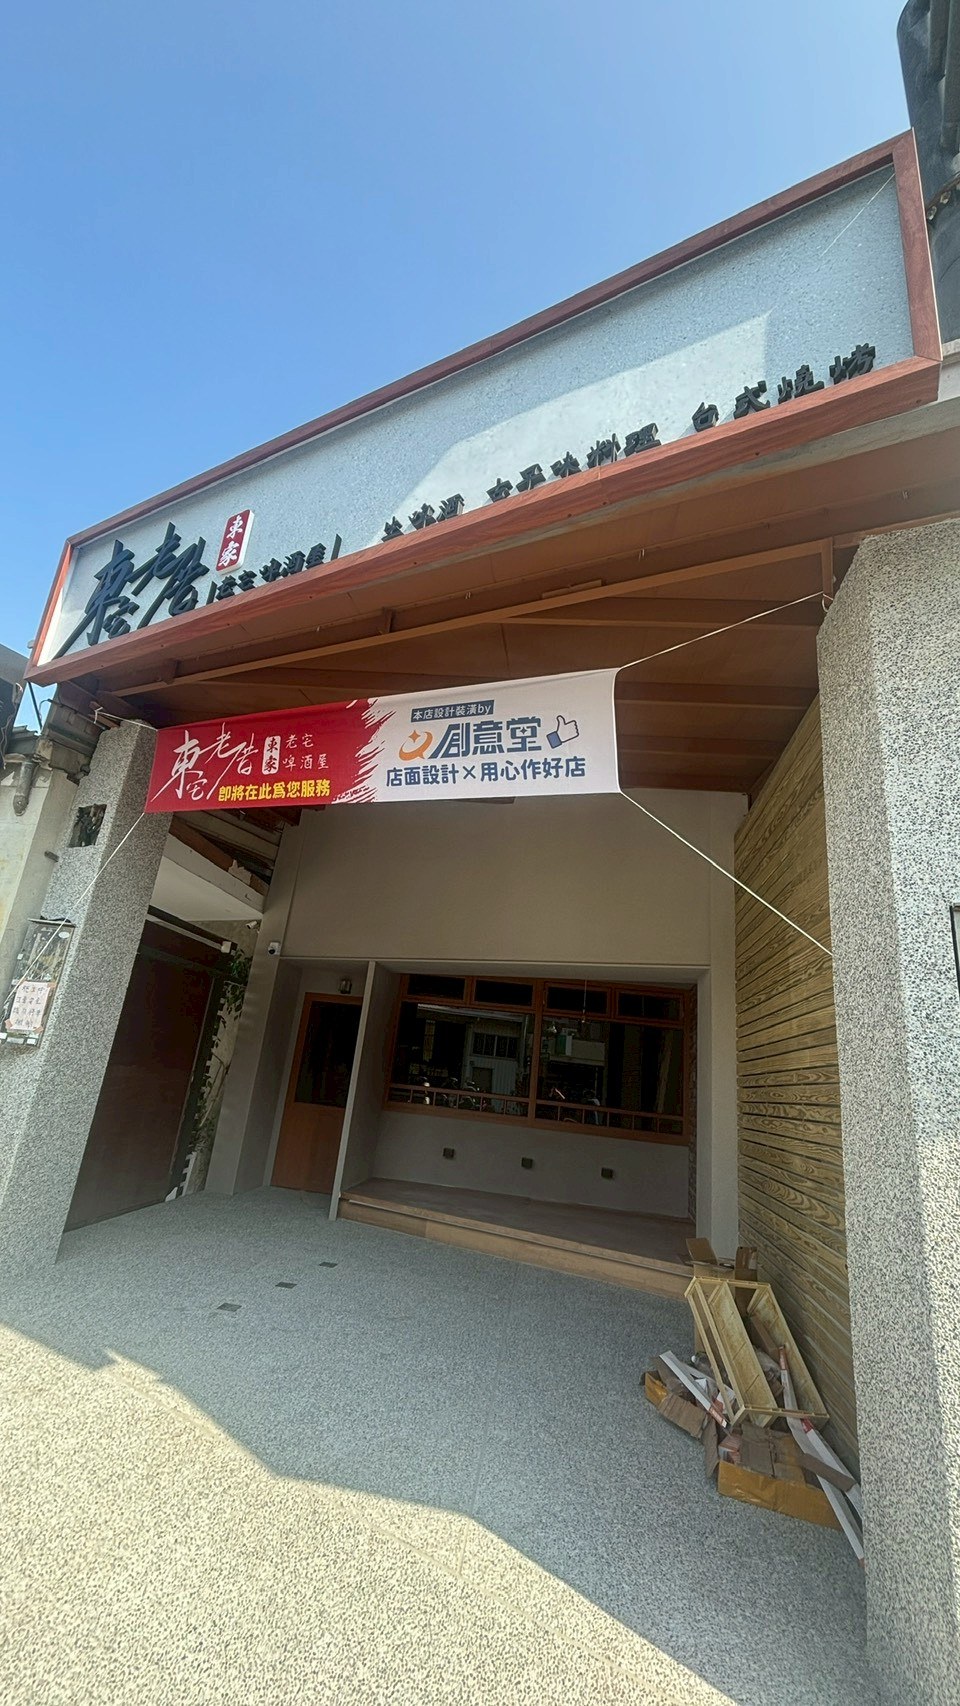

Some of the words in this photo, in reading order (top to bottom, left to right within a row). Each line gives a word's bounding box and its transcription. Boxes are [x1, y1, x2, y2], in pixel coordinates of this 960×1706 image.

[692, 343, 875, 431] 台式燒烤
[218, 514, 244, 567] 東家
[265, 737, 279, 772] 東家
[285, 733, 314, 749] 老宅
[428, 716, 541, 759] 創意堂
[282, 754, 329, 771] 啤酒屋
